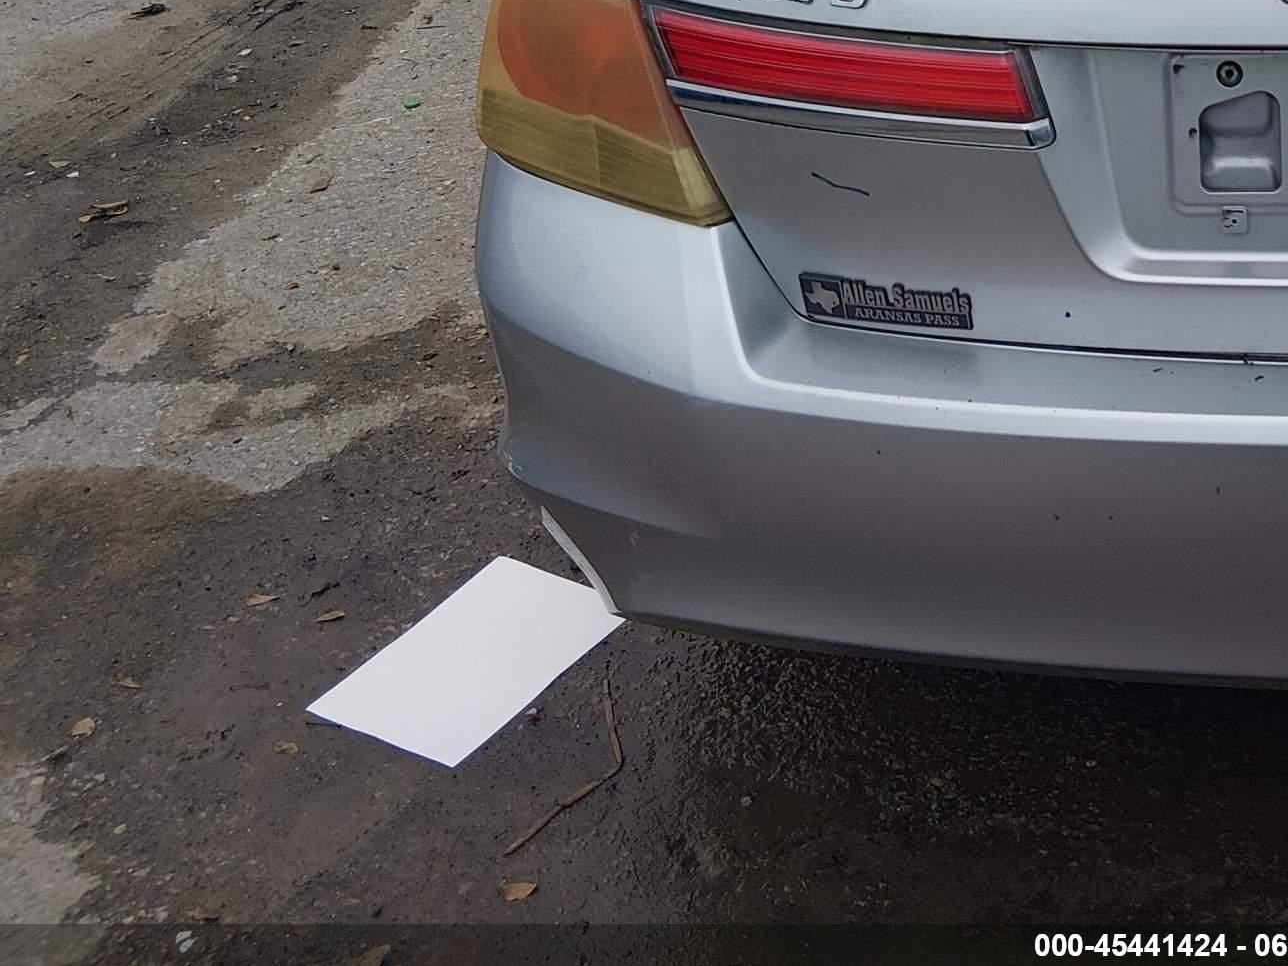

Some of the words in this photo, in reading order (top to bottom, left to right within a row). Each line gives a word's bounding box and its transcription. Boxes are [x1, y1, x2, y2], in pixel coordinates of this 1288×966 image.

[843, 281, 889, 307] Allen
[890, 284, 970, 314] Samuels
[854, 308, 922, 324] ARANSAS
[925, 313, 961, 327] PASS
